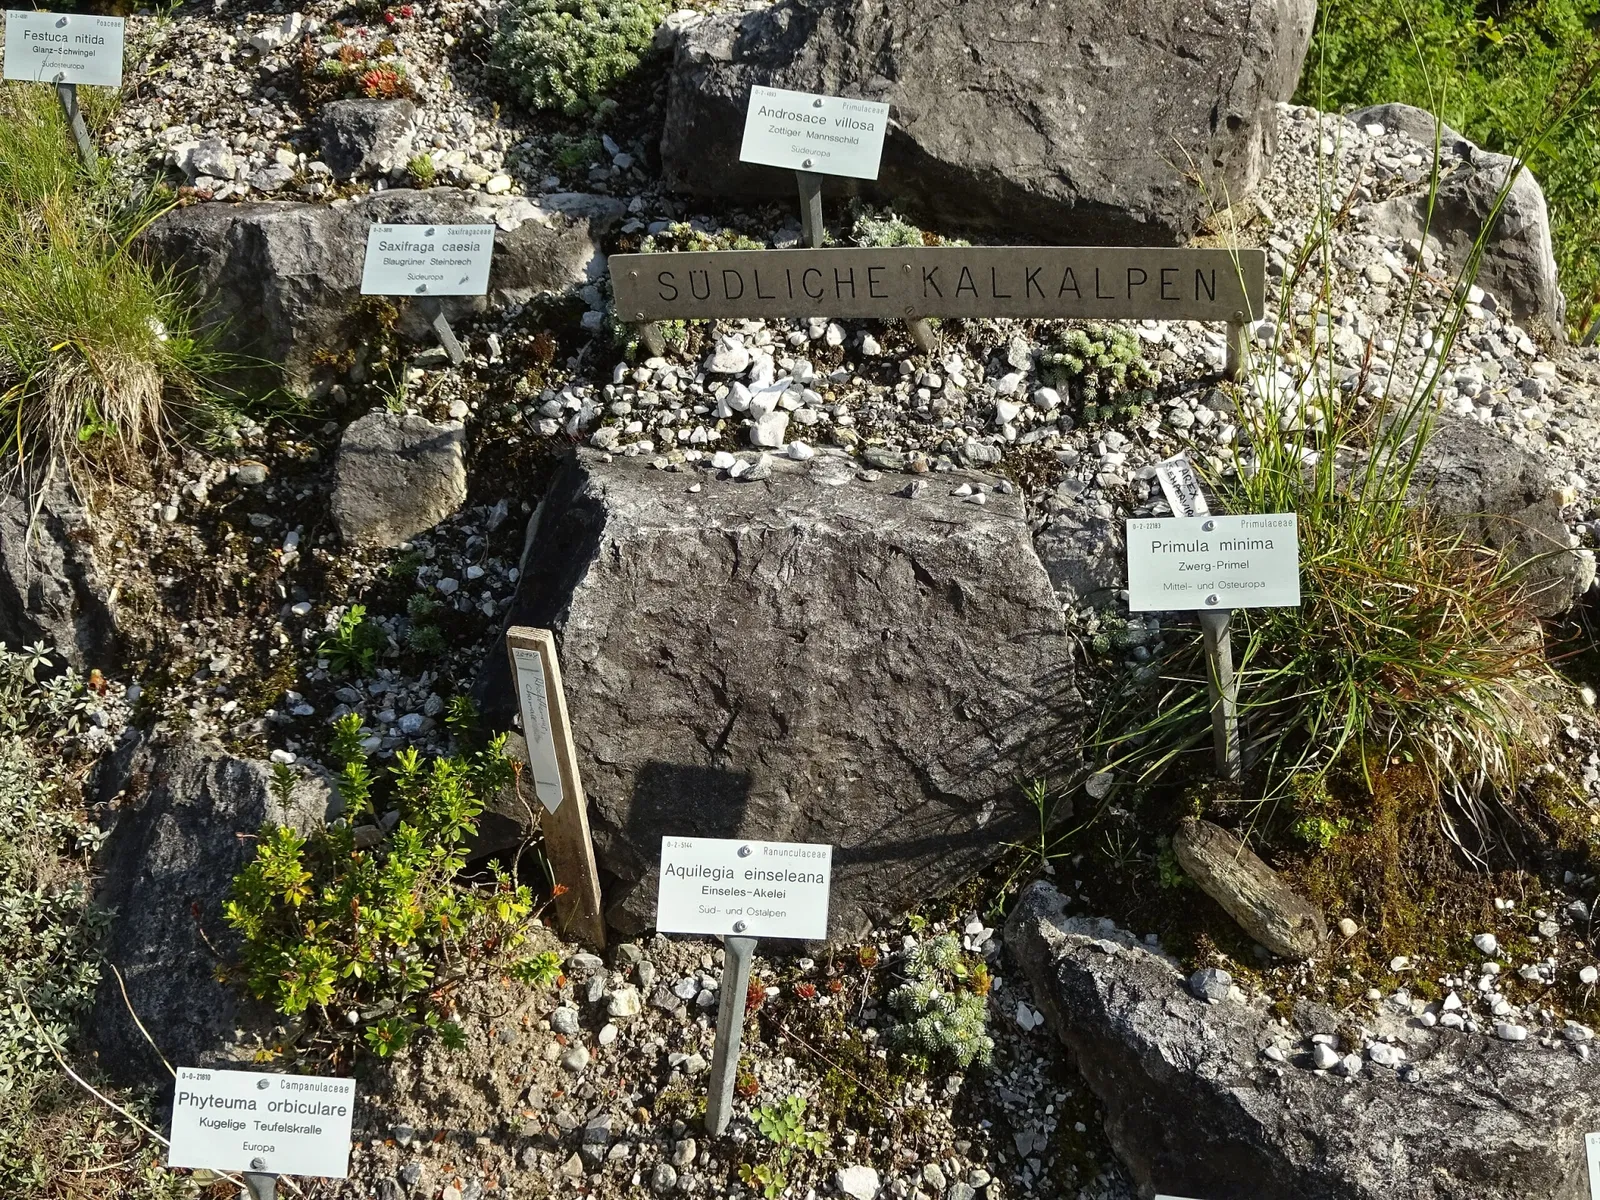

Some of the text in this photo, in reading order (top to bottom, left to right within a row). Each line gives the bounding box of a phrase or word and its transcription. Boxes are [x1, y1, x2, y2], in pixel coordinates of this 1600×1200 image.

[24, 29, 105, 45] Festuca nitida
[32, 45, 96, 58] Glanz-Schwingel
[842, 102, 885, 115] Primulaceae
[758, 105, 875, 132] Androsace villosa
[768, 125, 859, 145] Zottiger Mannsschild
[447, 228, 492, 237] Saxifragaceae
[378, 241, 480, 254] Saxifraga caesia
[383, 258, 472, 267] Blaugrüner Steinbrech
[657, 266, 1216, 301] SÜDLICHE KALKALPEN
[1175, 459, 1199, 500] CAREX
[1166, 462, 1195, 517] SEMPERVIR
[1240, 519, 1293, 529] Primulaceae
[1151, 537, 1274, 553] Primula minima
[1178, 560, 1250, 572] Zwerg-Primel
[1163, 580, 1266, 591] Mittel- und Osteuropa
[763, 846, 827, 859] Ranunculaceae
[664, 863, 825, 884] Aquilegia einseleana
[701, 885, 787, 899] Einseles-Akelei
[725, 907, 743, 916] und
[746, 907, 787, 919] Ostalpen
[280, 1079, 350, 1094] Campanulaceae
[178, 1091, 347, 1117] Phyteuma orbiculare
[199, 1117, 323, 1135] Kugelige Teufelskralle
[242, 1142, 276, 1154] Europa
